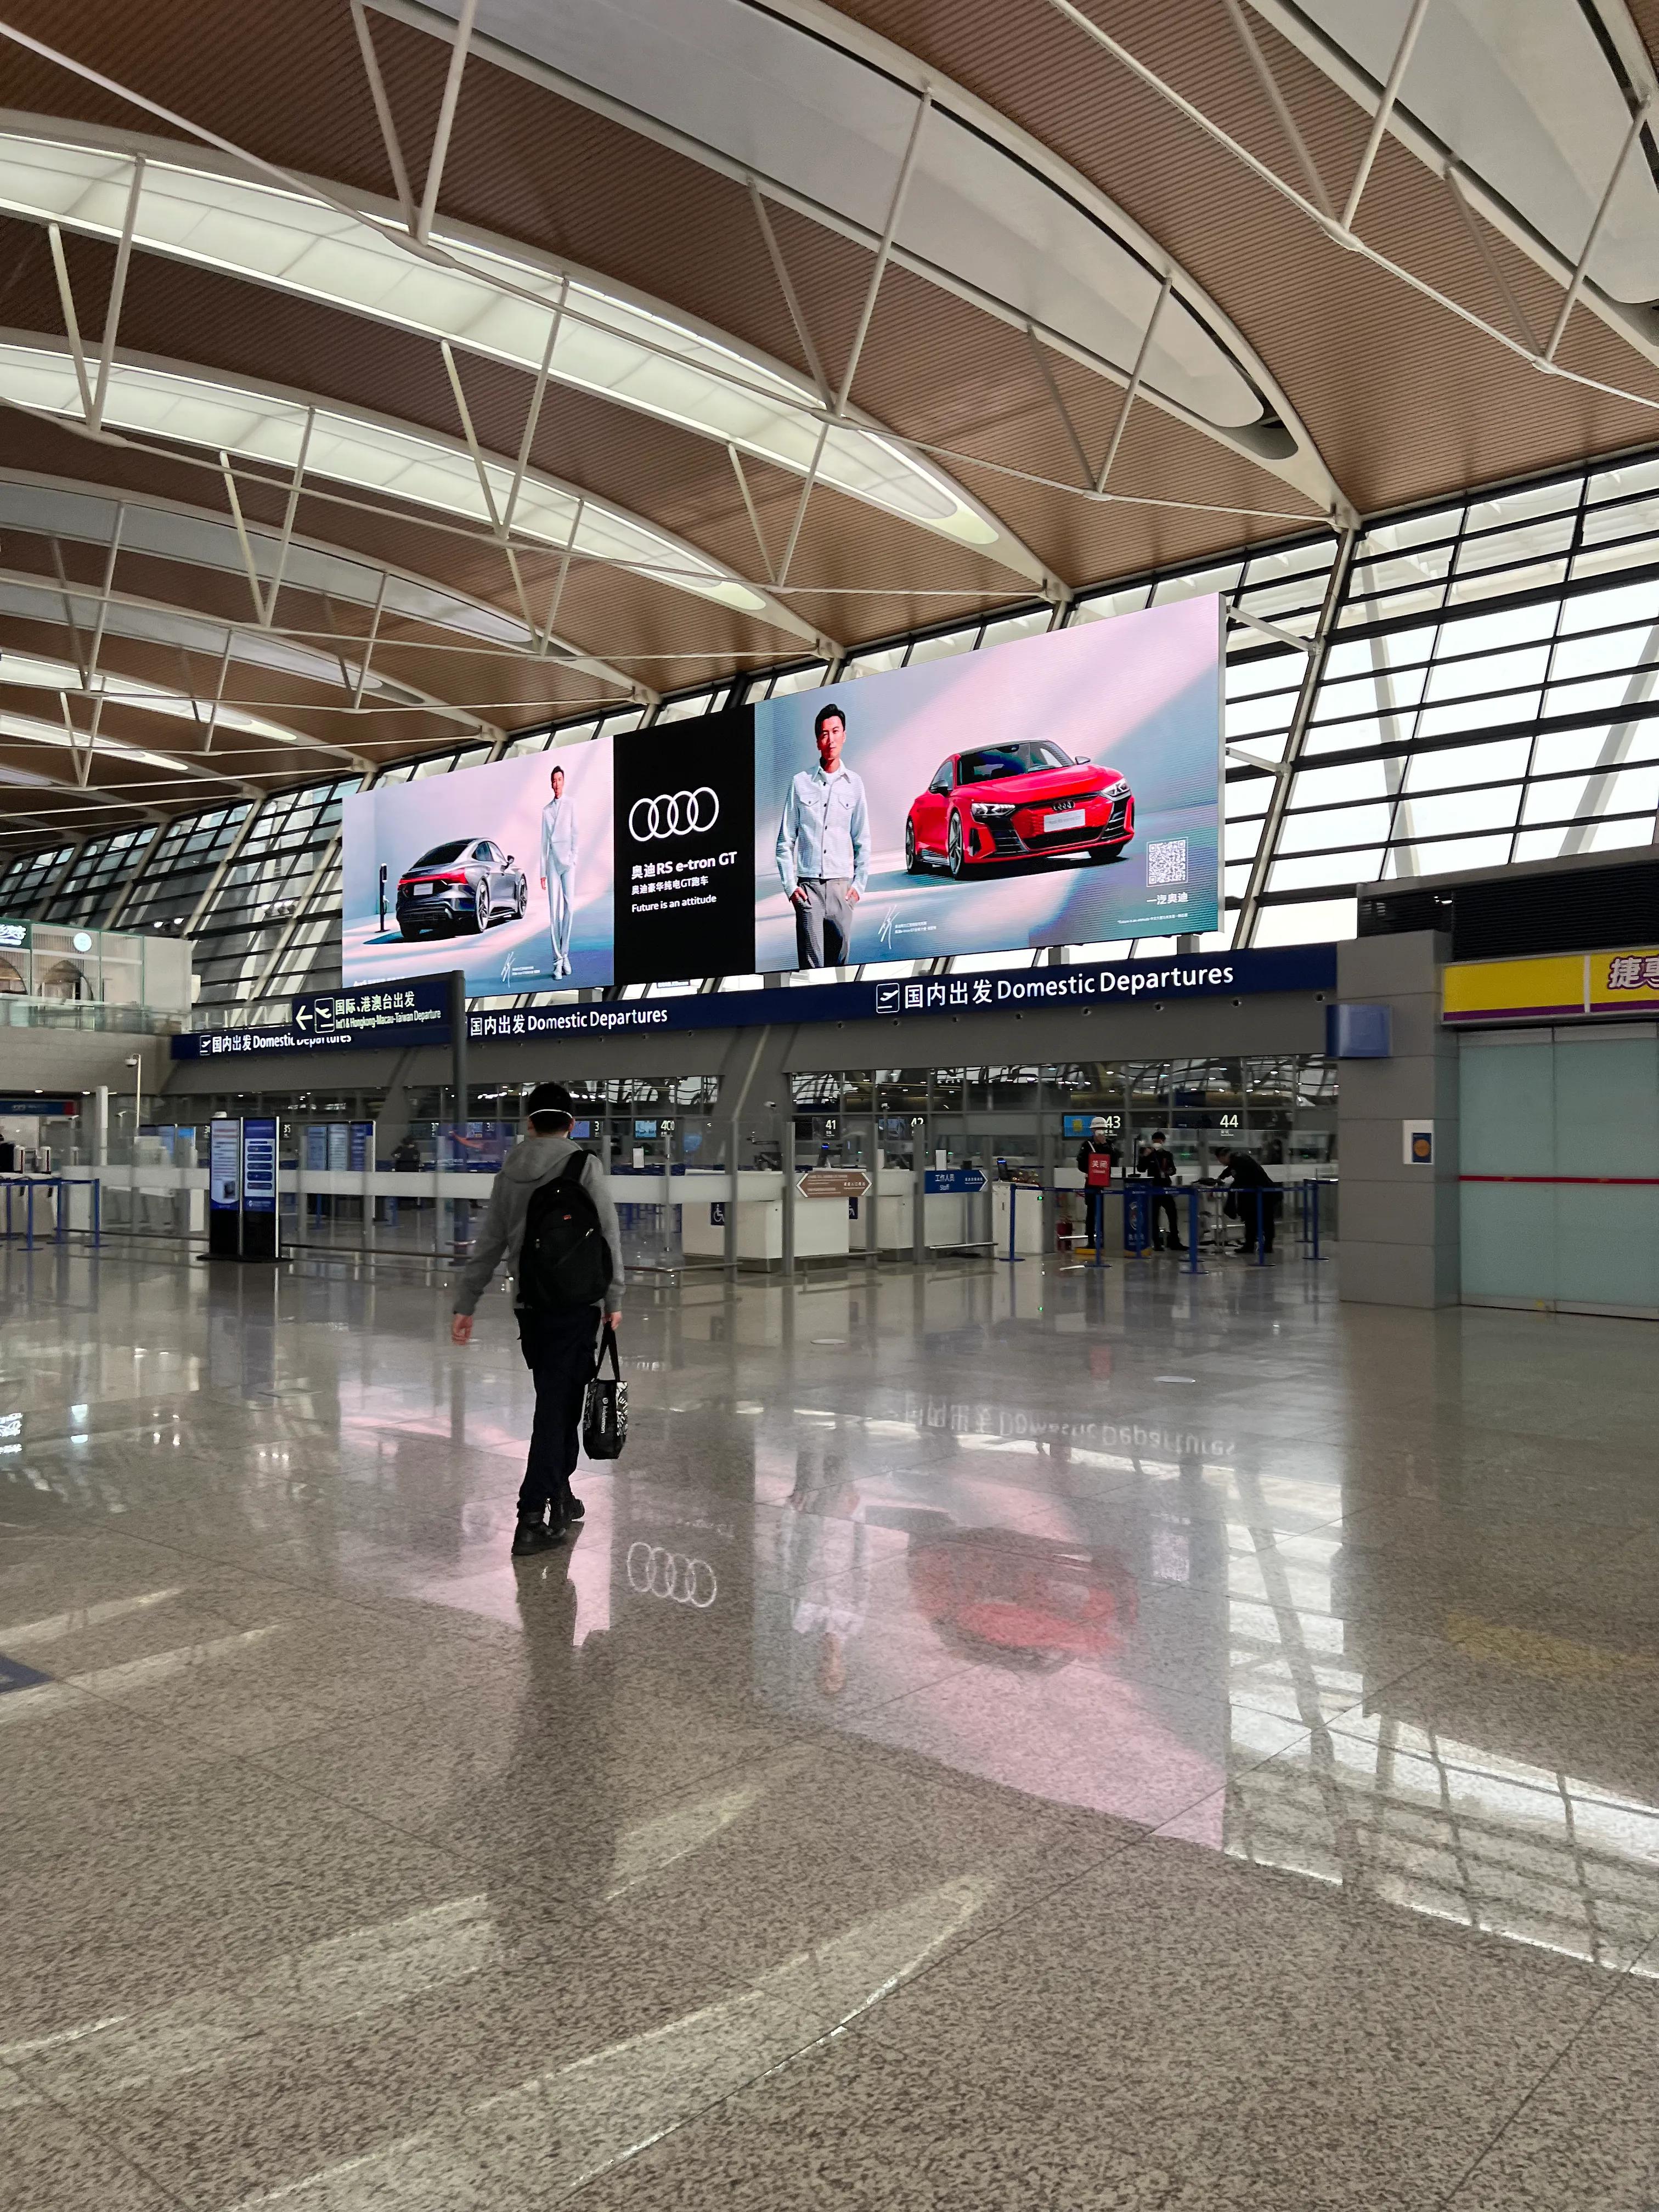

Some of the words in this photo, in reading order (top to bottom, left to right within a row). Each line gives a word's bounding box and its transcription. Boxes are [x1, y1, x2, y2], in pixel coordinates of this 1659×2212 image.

[631, 861, 673, 879] 奥迪RS
[675, 857, 716, 872] e-tron
[718, 851, 738, 866] GT
[631, 876, 709, 895] 奥迪豪华纯电GT跑车
[631, 903, 659, 913] Future
[660, 900, 668, 909] is
[681, 894, 717, 906] attitude
[1146, 891, 1189, 905] 一汽奥迪
[904, 979, 992, 1009] 国内出发
[997, 972, 1095, 999] Domestic
[1101, 967, 1233, 995] Departures
[335, 991, 415, 1015] 国际、港澳台出发
[471, 1014, 526, 1036] 国内出发
[528, 1012, 588, 1031] Domestic
[590, 1009, 668, 1030] Departures
[212, 1034, 252, 1053] 国内出发
[253, 1032, 296, 1049] Domestic
[825, 1119, 836, 1130] 41
[1105, 1115, 1121, 1128] 43
[1220, 1114, 1239, 1128] 44
[935, 1173, 955, 1182] 工作人员
